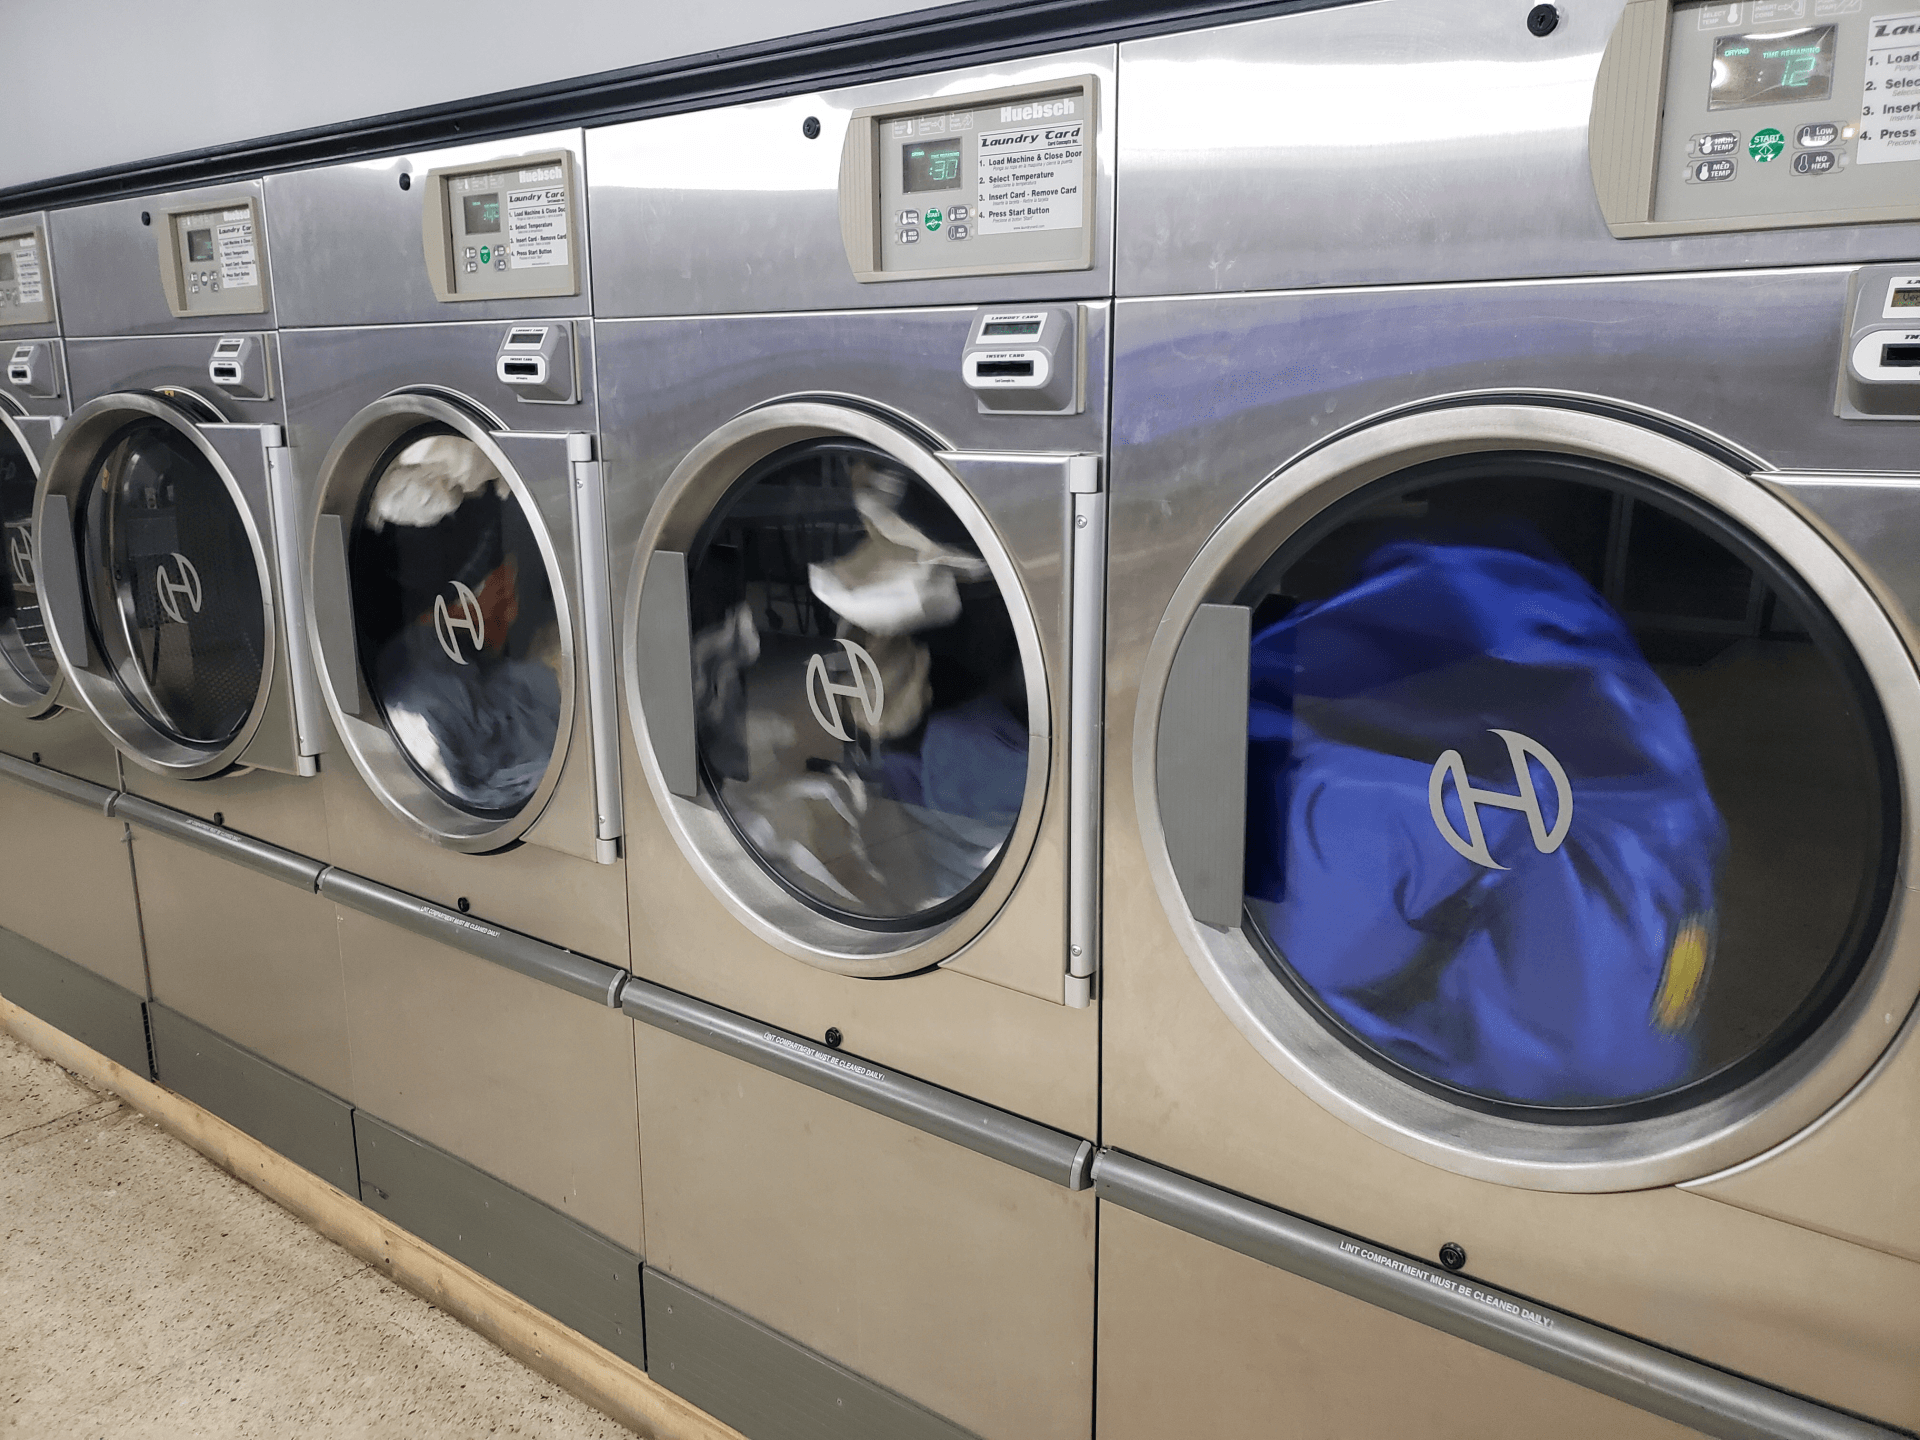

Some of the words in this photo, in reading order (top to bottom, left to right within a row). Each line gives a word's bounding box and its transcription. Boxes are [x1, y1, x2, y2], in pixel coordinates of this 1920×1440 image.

[1724, 47, 1750, 57] DRYING
[1763, 51, 1779, 59] TIME
[1780, 46, 1820, 57] REMAINING
[1868, 56, 1879, 66] 1.
[1887, 51, 1920, 64] Load
[1865, 81, 1877, 91] 2.
[1000, 98, 1075, 123] Huebsch
[1863, 106, 1874, 116] 3.
[1883, 102, 1920, 114] Insert
[1816, 127, 1833, 135] LOW
[1860, 131, 1872, 140] 4.
[1880, 129, 1916, 139] Press
[981, 133, 1039, 147] Laundry
[1045, 127, 1081, 139] Card
[1754, 135, 1779, 143] START
[1714, 143, 1734, 151] TEMP
[988, 157, 1005, 166] Load
[1006, 154, 1035, 164] Machine
[1036, 153, 1042, 161] &
[1044, 152, 1063, 160] Close
[1065, 150, 1082, 158] Door
[1811, 161, 1830, 169] HEAT
[519, 166, 562, 183] Huebsch
[988, 174, 1010, 183] Select
[1012, 171, 1054, 181] Temperature
[1711, 169, 1730, 177] TEMP
[509, 193, 542, 202] Laundry
[988, 193, 1008, 201] Insert
[1010, 190, 1025, 199] Card
[1031, 188, 1059, 197] Remove
[1060, 185, 1077, 194] Card
[988, 210, 1007, 218] Press
[1008, 208, 1025, 216] Start
[1027, 207, 1050, 215] Button
[528, 222, 552, 230] Temperature
[775, 1036, 816, 1056] COMPARTMENT
[815, 1050, 832, 1061] MUST
[830, 1056, 840, 1065] BE
[839, 1059, 867, 1075] CLEANED
[865, 1069, 885, 1081] DAILY!
[1339, 1240, 1360, 1255] LINT
[1360, 1249, 1430, 1281] COMPARTMENT
[1429, 1274, 1458, 1292] MUST
[1458, 1285, 1472, 1298] BE
[1473, 1290, 1520, 1315] CLEANED
[1521, 1308, 1554, 1329] DAILY!
